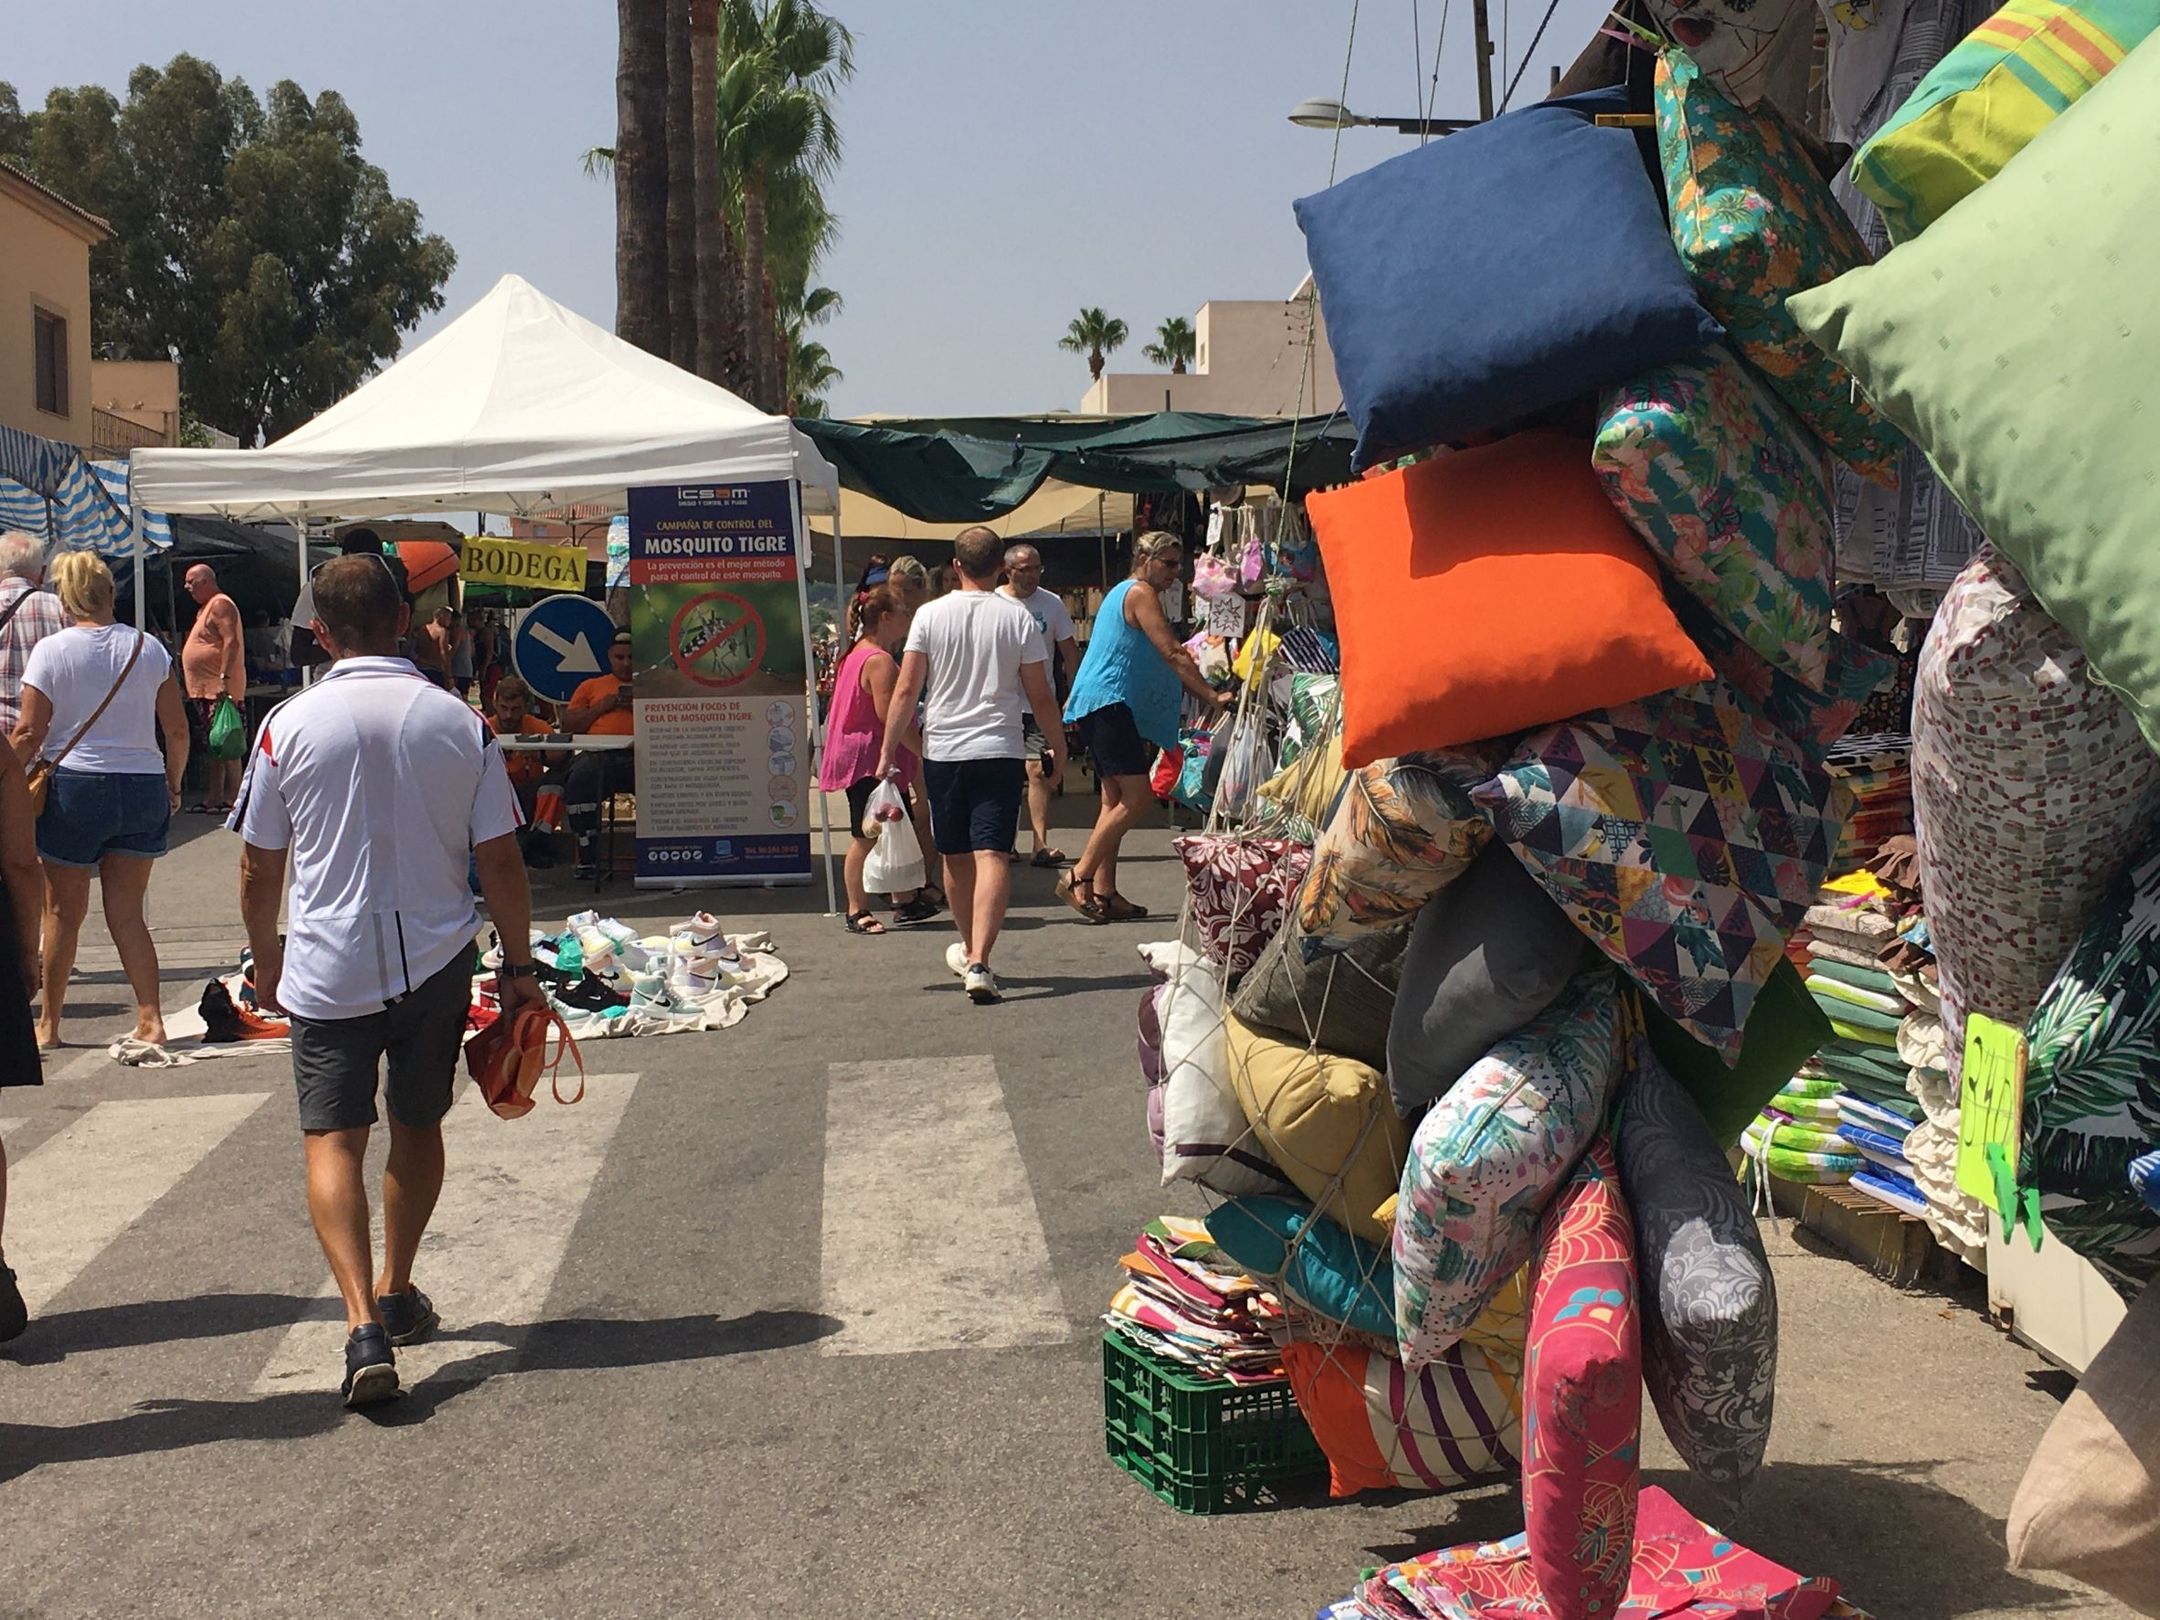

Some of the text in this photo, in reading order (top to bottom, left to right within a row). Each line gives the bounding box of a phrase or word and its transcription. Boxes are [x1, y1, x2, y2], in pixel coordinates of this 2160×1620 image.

[656, 519, 773, 531] CAMPAÑA DE CONTROL DEL
[645, 536, 787, 556] MOSQUITO TIGRE
[466, 548, 580, 582] BODEGA
[647, 561, 657, 570] La
[658, 561, 704, 572] prevención
[717, 560, 725, 569] el
[727, 560, 751, 571] mejor
[753, 558, 786, 568] método
[650, 573, 669, 582] para
[671, 571, 679, 581] el
[680, 570, 709, 580] control
[710, 570, 721, 579] de
[723, 571, 740, 579] este
[700, 702, 727, 711] FOCOS
[729, 702, 741, 710] DE
[667, 713, 678, 722] DE
[680, 712, 725, 723] MOSQUITO
[728, 711, 752, 721] TIGRE
